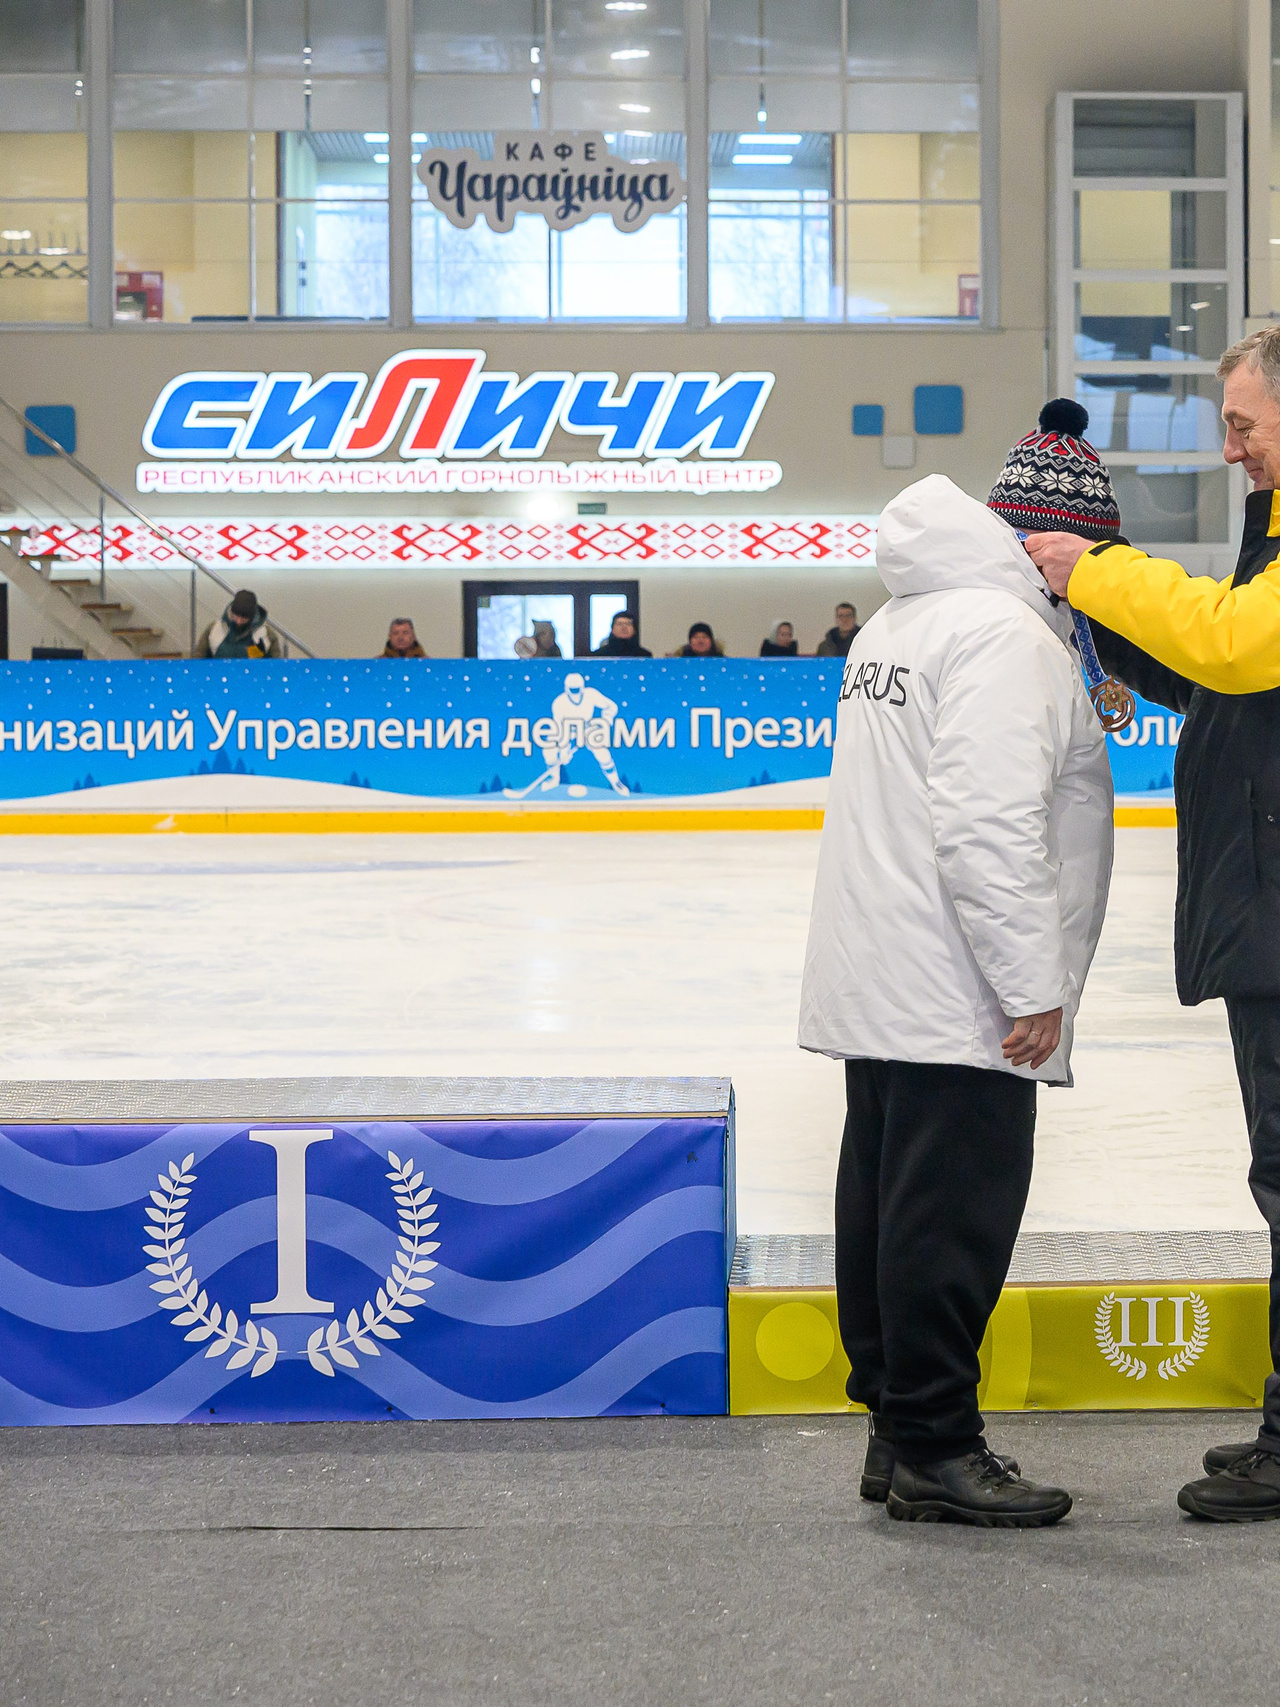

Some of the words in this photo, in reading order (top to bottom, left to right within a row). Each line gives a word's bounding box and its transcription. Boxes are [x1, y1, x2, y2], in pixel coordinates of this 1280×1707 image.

[506, 142, 597, 161] КАФЕ
[144, 466, 438, 485] РЕСПУБЛИКАНСКИЙ
[446, 466, 676, 484] ГОРНОЛЫЖНЫЙ
[686, 469, 774, 486] ЦЕНТР
[0, 708, 195, 760] низаций
[205, 708, 490, 761] Управления
[501, 715, 677, 757] делами
[249, 1129, 334, 1314] I
[1114, 1297, 1190, 1347] III
